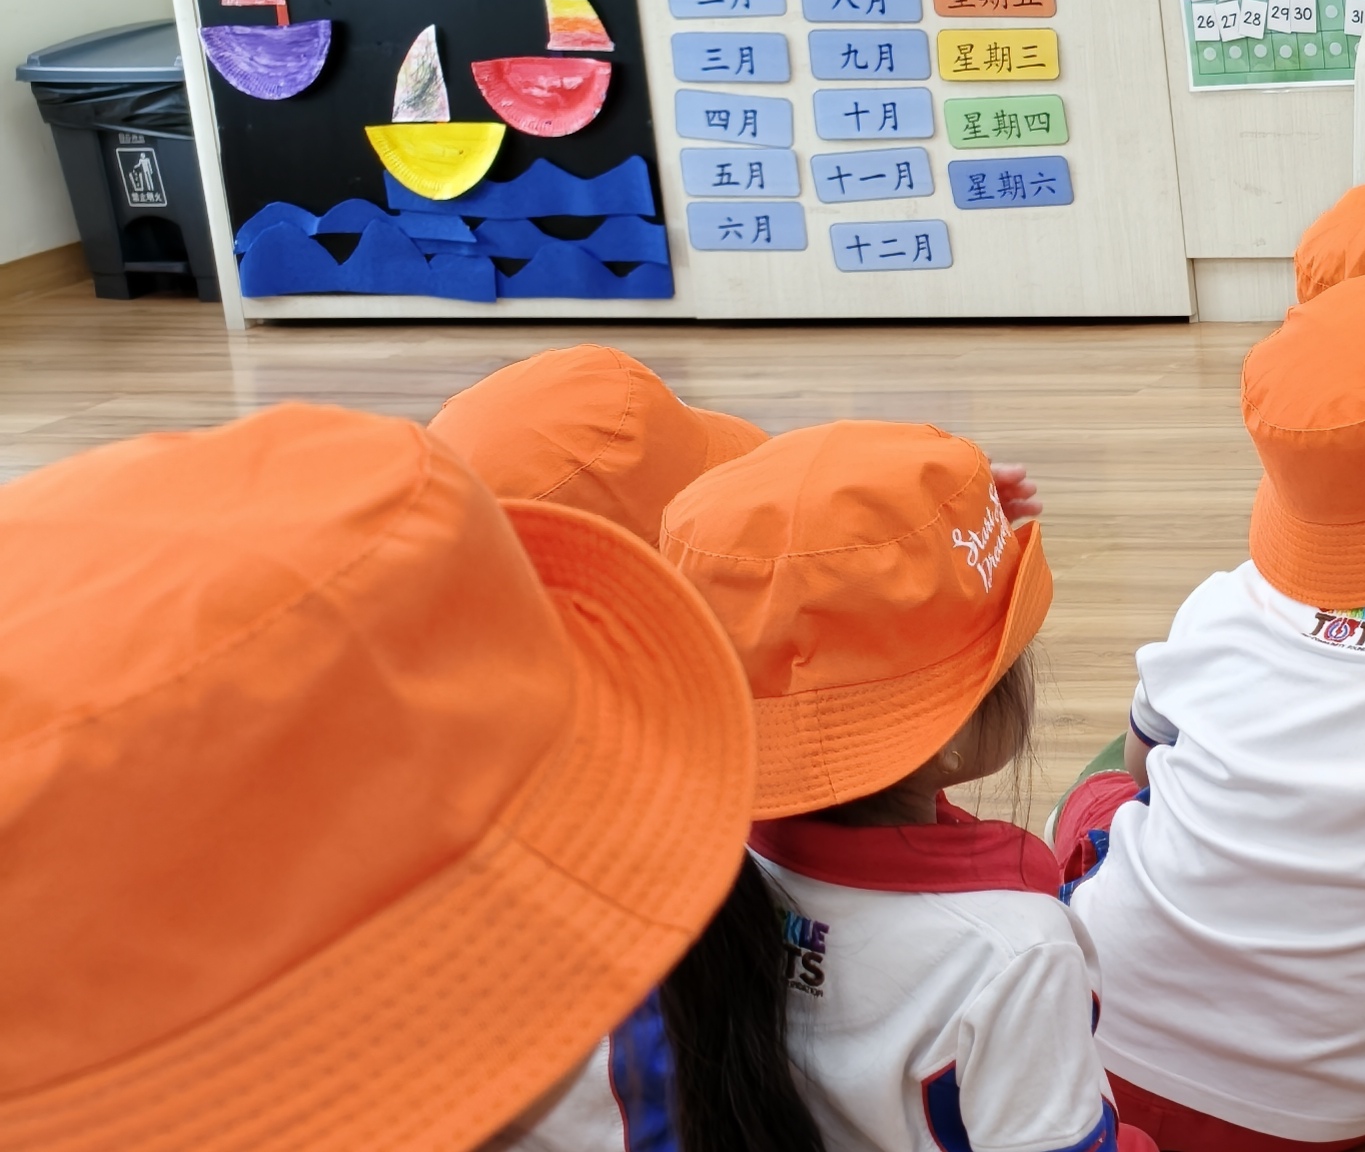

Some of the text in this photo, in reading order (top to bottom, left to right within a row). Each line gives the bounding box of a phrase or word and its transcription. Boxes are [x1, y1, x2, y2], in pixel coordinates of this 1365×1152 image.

[1197, 6, 1364, 29] 26 27 28 29 30 31
[701, 45, 756, 76] 三月
[840, 42, 896, 73] 九月
[951, 41, 1047, 75] 星期三
[705, 108, 759, 138] 四月
[843, 101, 899, 132] 十月
[961, 109, 1052, 142] 星期四
[712, 160, 766, 191] 五月
[826, 159, 914, 195] 十一月
[966, 171, 1058, 203] 星期六
[717, 214, 772, 245] 六月
[845, 232, 934, 265] 十二月
